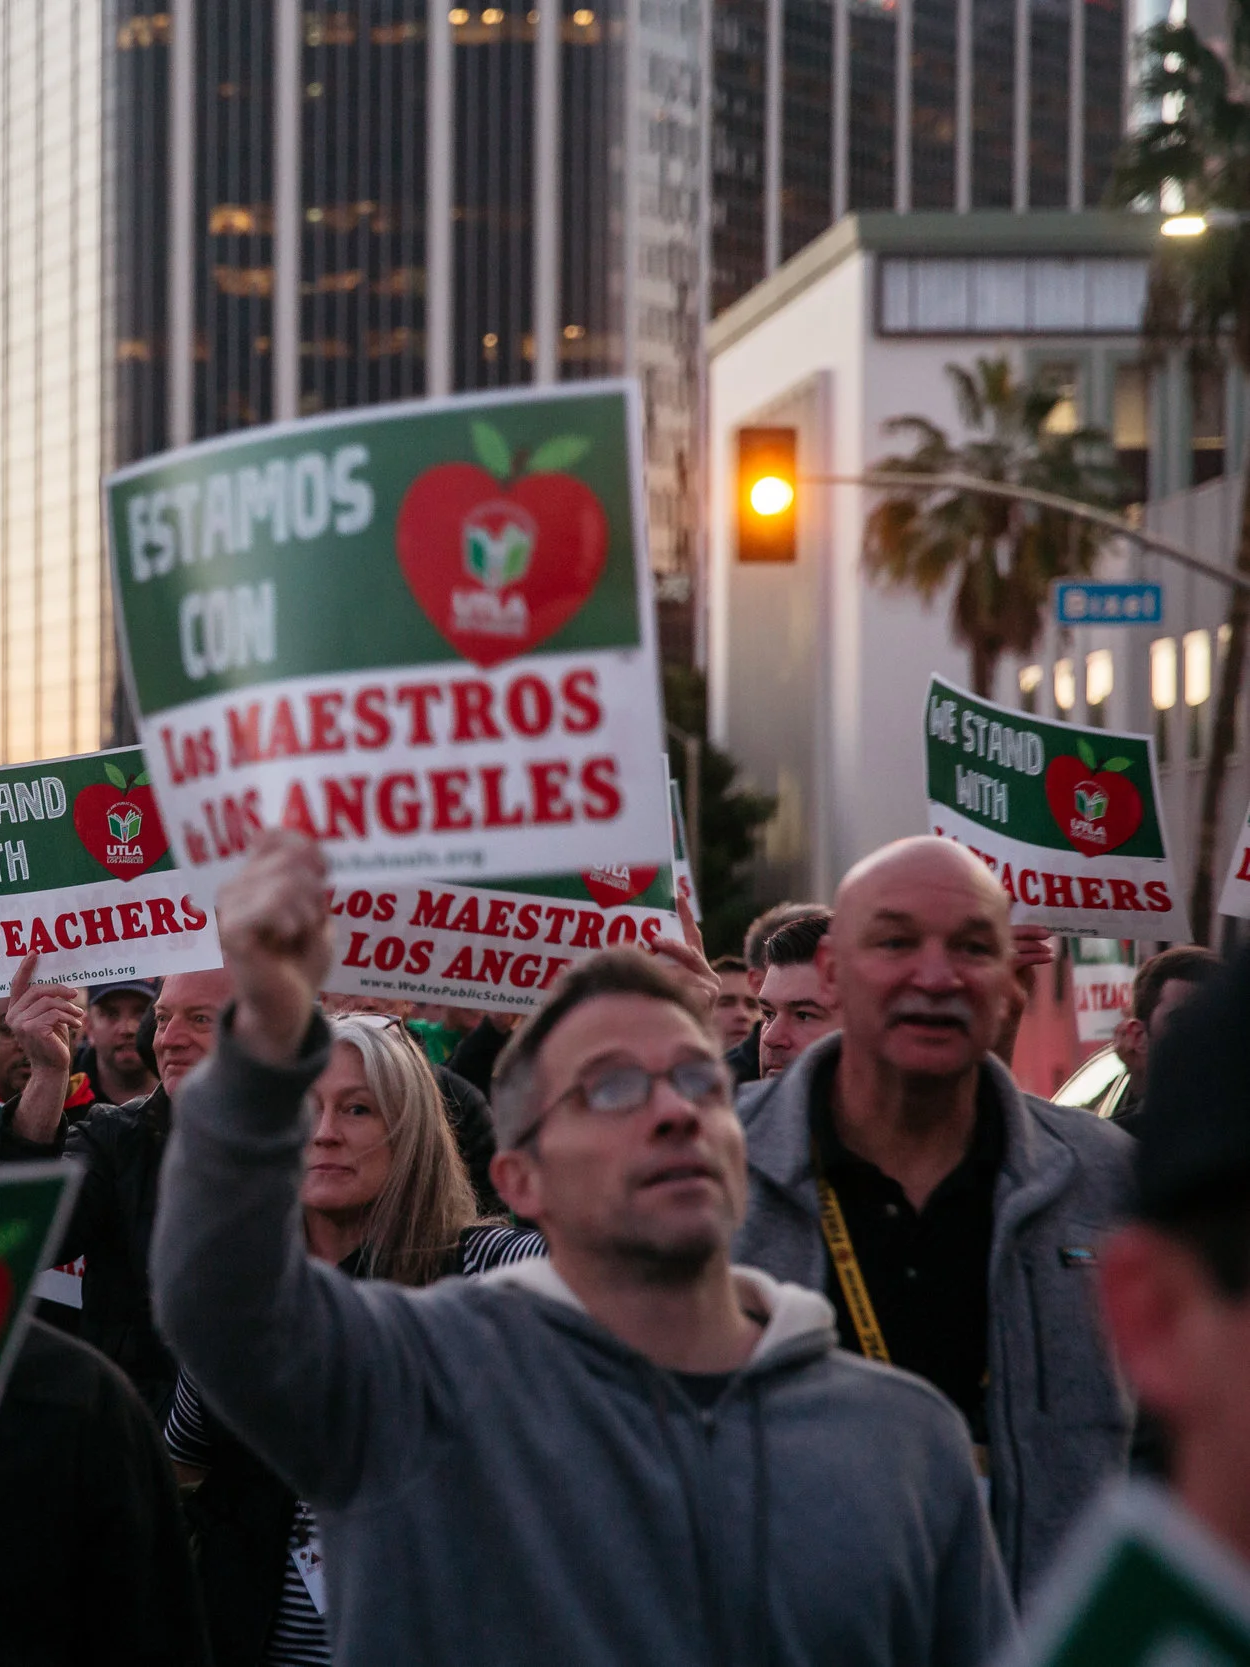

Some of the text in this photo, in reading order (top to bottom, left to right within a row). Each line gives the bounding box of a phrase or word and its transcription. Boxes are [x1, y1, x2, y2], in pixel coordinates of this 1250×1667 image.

[127, 443, 375, 584] ESTAMOS
[179, 580, 280, 682] CON
[225, 668, 604, 769] MAESTROS
[928, 694, 1044, 776] WE STAND
[281, 752, 624, 845] ANGELES
[955, 763, 1009, 824] WITH
[106, 844, 143, 856] UTLA
[341, 931, 435, 976] LOS
[408, 890, 662, 955] MAESTROS
[359, 976, 538, 1006] www.WeArePublicSchools.
